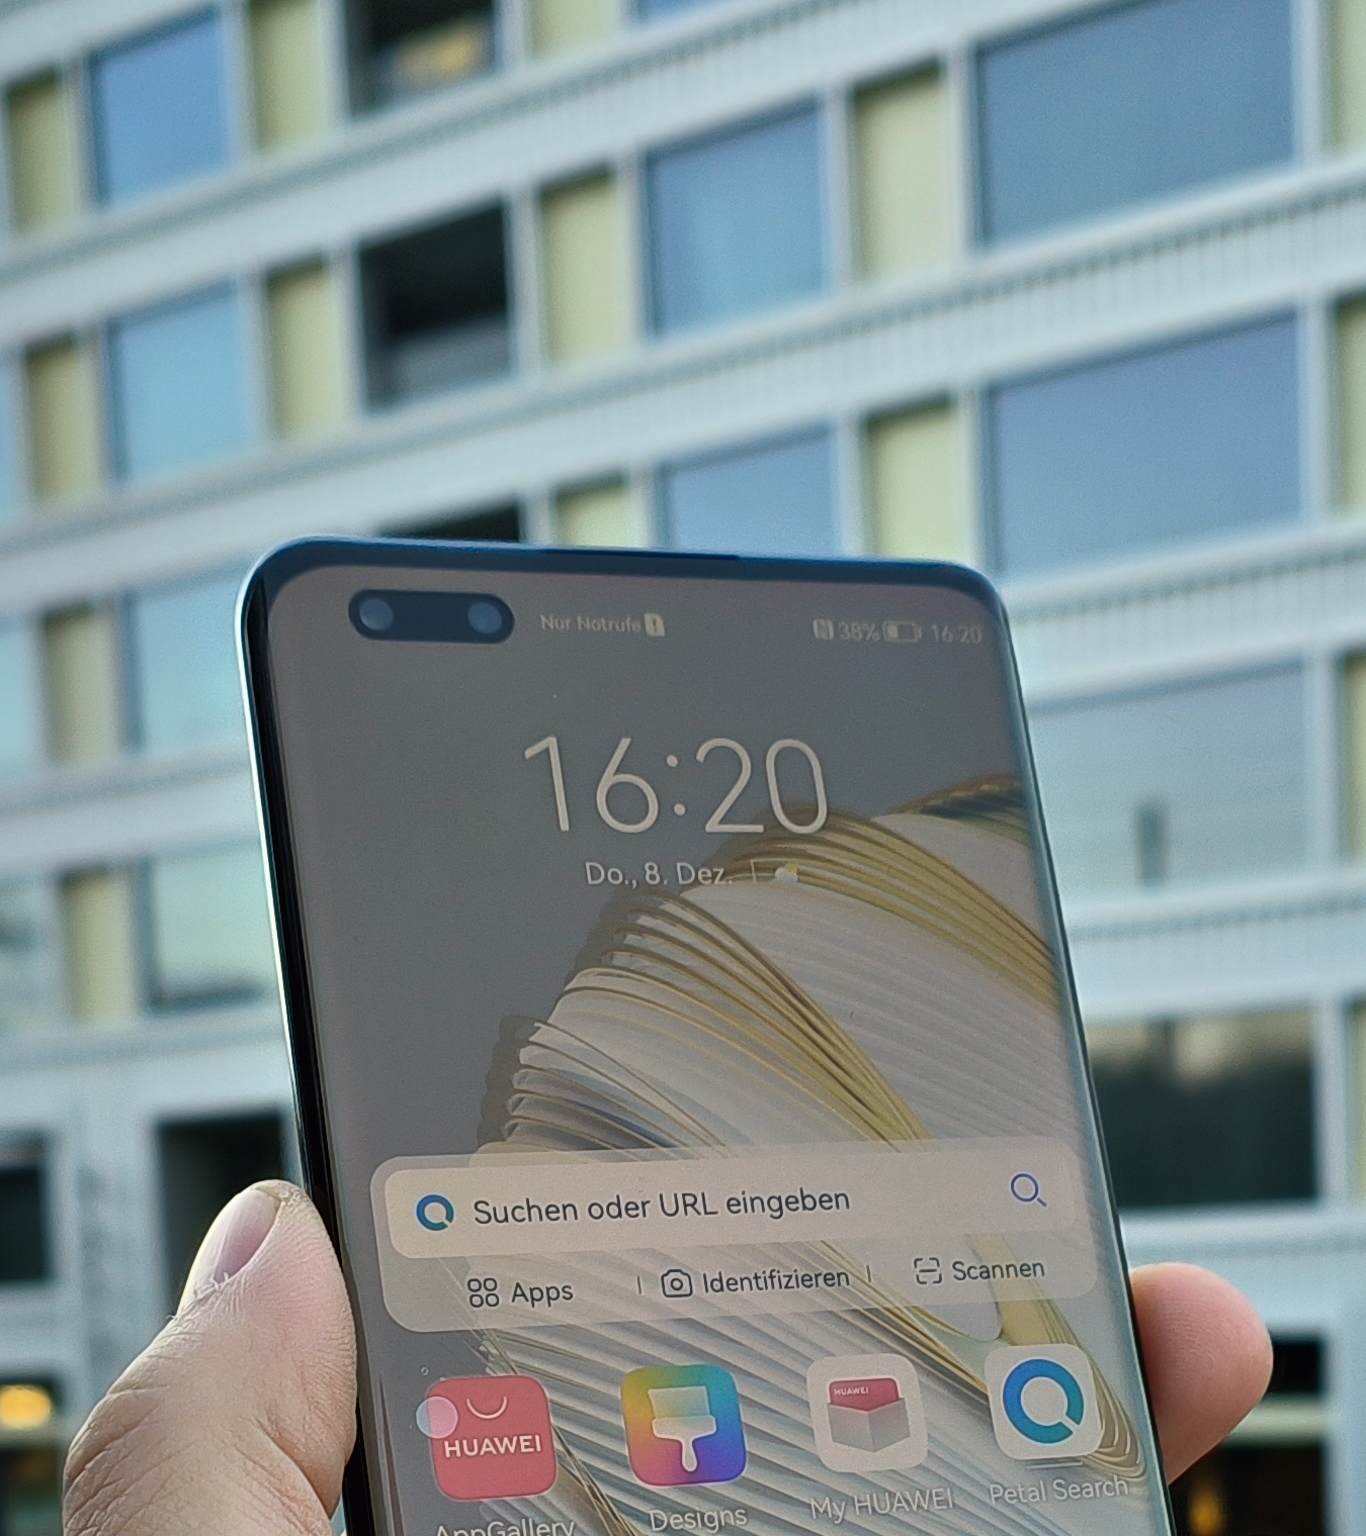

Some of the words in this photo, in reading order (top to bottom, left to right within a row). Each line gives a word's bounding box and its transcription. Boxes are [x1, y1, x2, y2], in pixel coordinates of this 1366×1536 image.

[838, 621, 881, 641] 38%
[524, 736, 829, 834] 16:20
[585, 861, 638, 889] Do.,
[644, 861, 669, 885] 8.
[676, 862, 734, 885] Dez.
[473, 1197, 579, 1225] Suchen
[586, 1195, 652, 1221] oder
[658, 1191, 719, 1218] URL
[726, 1187, 851, 1220] eingeben
[702, 1268, 851, 1293] Identifizieren
[951, 1259, 1046, 1282] Scannen
[511, 1280, 575, 1306] Apps
[443, 1434, 542, 1458] HUAWEI
[810, 1497, 850, 1521] My
[854, 1488, 954, 1517] HUAWEI
[989, 1480, 1049, 1506] Petal
[1053, 1476, 1128, 1500] Search
[649, 1506, 748, 1533] Designs
